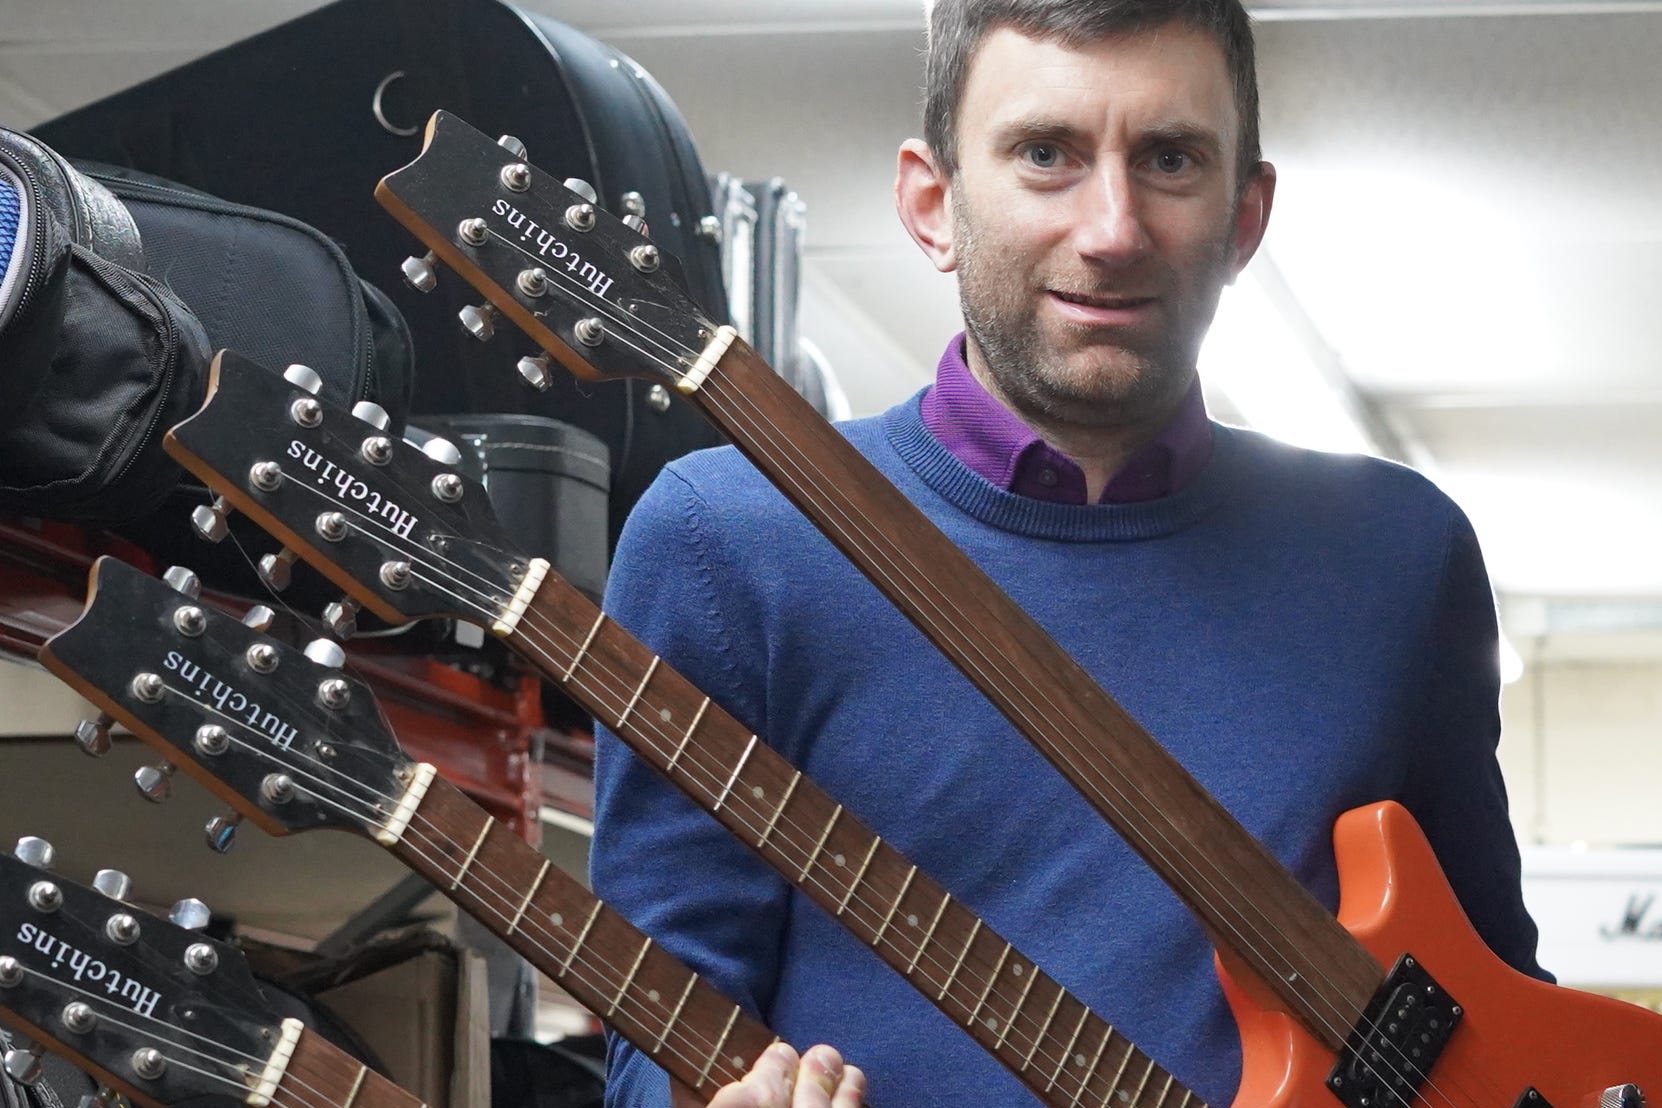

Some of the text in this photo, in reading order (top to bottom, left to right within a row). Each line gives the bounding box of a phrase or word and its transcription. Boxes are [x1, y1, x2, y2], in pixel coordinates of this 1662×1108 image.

[491, 199, 615, 298] Hutchins
[287, 440, 419, 539] Hutchins
[163, 650, 299, 751] Hutchins
[17, 922, 162, 1018] Hutchins
